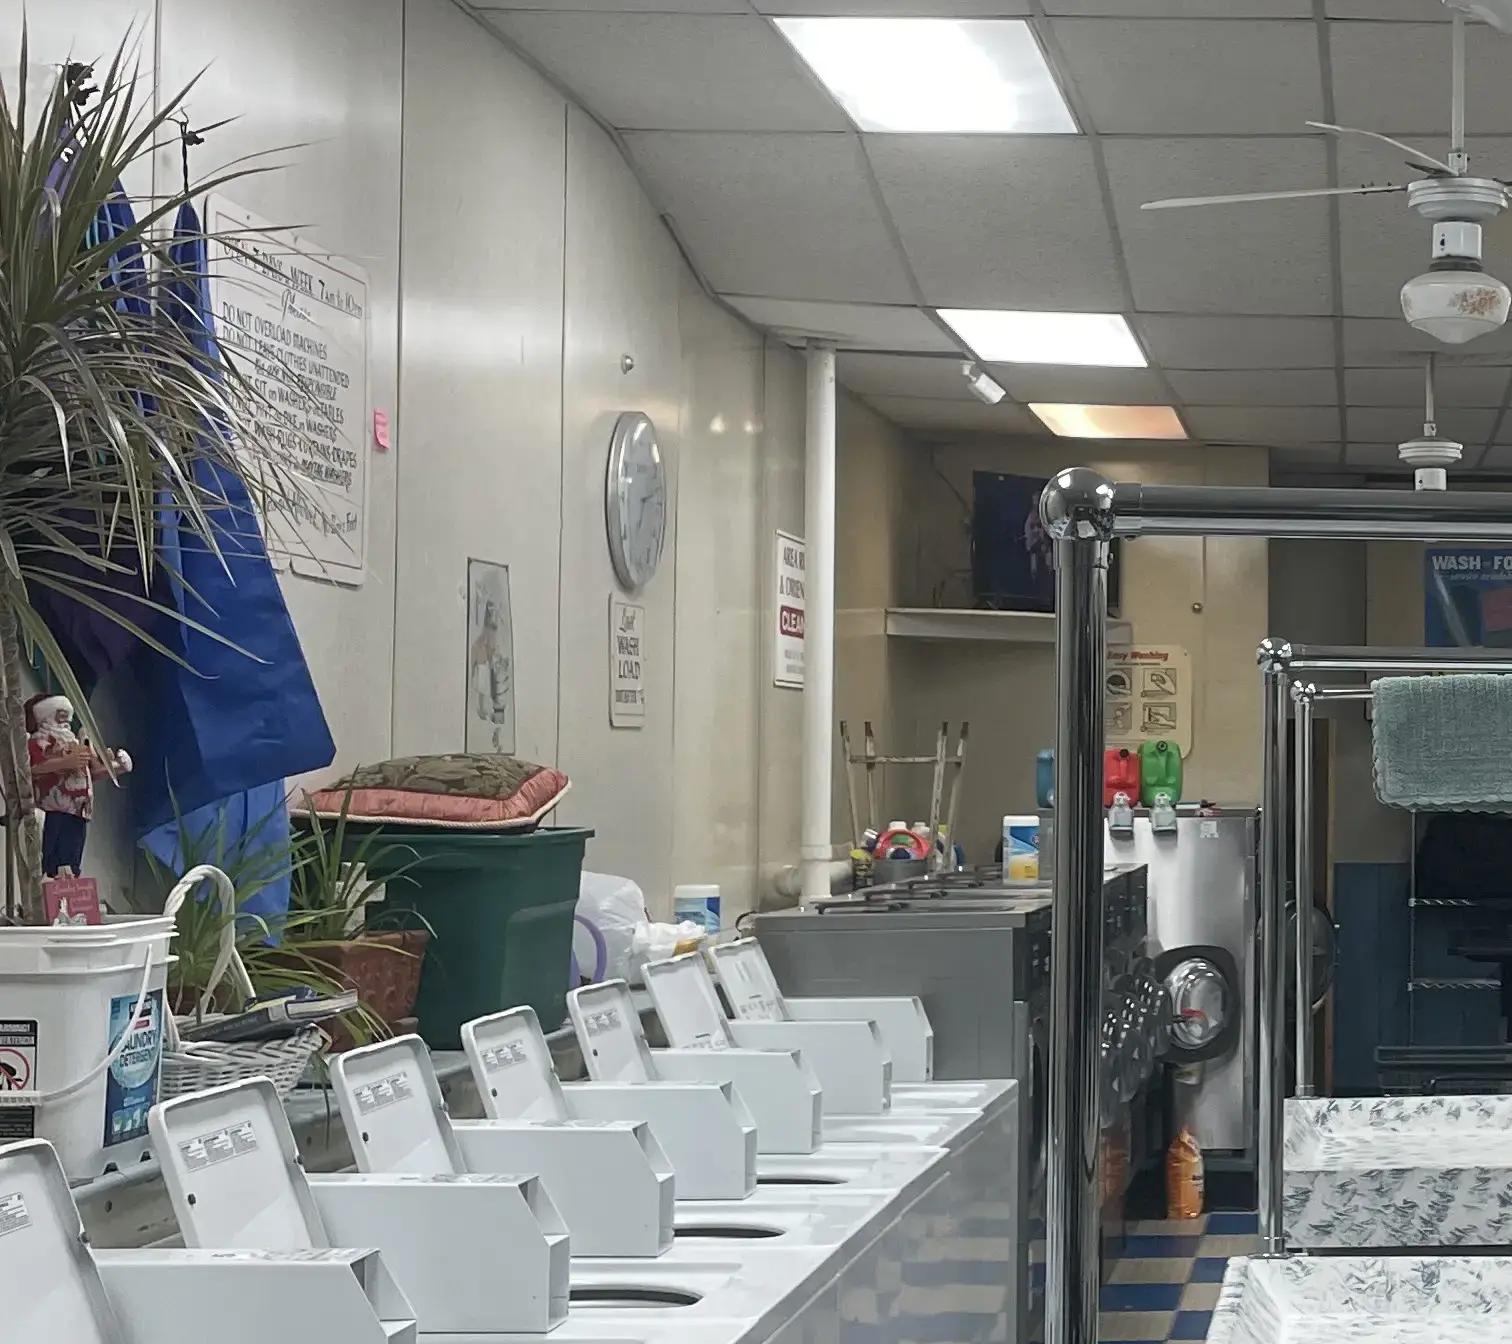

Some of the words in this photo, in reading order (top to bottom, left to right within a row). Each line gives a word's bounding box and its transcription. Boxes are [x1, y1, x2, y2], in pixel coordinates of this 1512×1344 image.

[237, 307, 252, 333] NOT
[254, 314, 291, 348] OVERLOAD
[293, 331, 328, 360] MACHINES
[308, 357, 350, 389] UNATTENDED
[1432, 555, 1480, 570] WASH
[618, 659, 641, 680] LOAD
